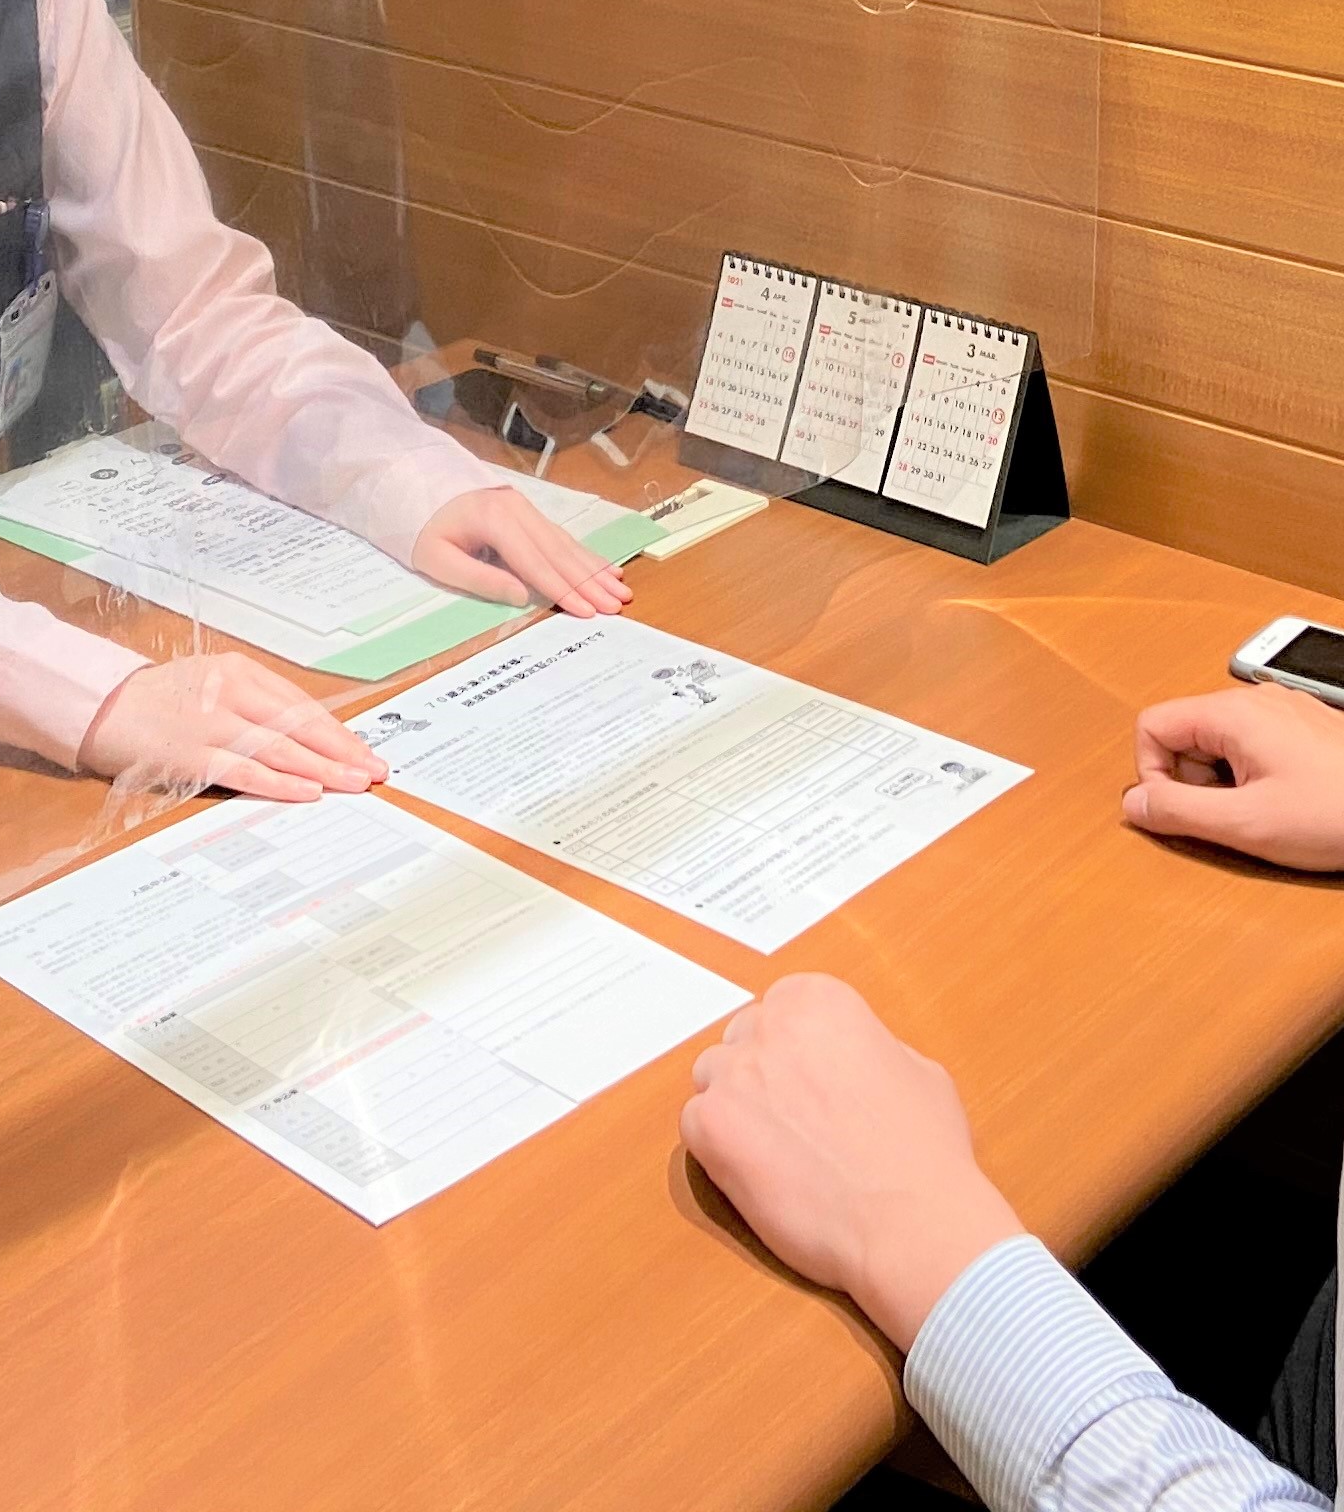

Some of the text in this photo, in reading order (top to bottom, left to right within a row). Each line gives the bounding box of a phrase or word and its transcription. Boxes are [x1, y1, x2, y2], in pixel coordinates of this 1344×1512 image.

[760, 287, 770, 301] 4
[769, 320, 797, 335] 1 2 3
[847, 311, 858, 325] 5
[717, 331, 723, 339] 4
[740, 338, 746, 346] 6
[751, 341, 758, 349] 7
[762, 343, 768, 352] 8
[775, 347, 780, 355] 9
[784, 350, 794, 359] 10
[966, 343, 976, 359] 3
[711, 353, 719, 363] 11
[722, 356, 731, 366] 12
[734, 360, 742, 370] 13
[745, 363, 754, 373] 14
[767, 370, 777, 379] 16
[779, 373, 789, 382] 17
[814, 359, 820, 367] 9
[825, 362, 834, 372] 10
[836, 365, 845, 375] 11
[705, 377, 714, 386] 18
[716, 379, 726, 389] 19
[727, 383, 737, 392] 20
[750, 390, 760, 400] 22
[773, 397, 783, 407] 24
[937, 368, 941, 377] 1
[949, 372, 955, 381] 2
[961, 375, 968, 384] 3
[975, 379, 981, 388] 4
[988, 383, 993, 392] 5
[1000, 386, 1007, 396] 6
[819, 386, 828, 394] 17
[831, 389, 840, 398] 18
[843, 392, 852, 401] 19
[854, 396, 864, 405] 20
[699, 400, 708, 409] 25
[710, 403, 720, 413] 26
[721, 406, 731, 415] 27
[732, 410, 742, 420] 28
[744, 413, 754, 422] 29
[930, 393, 936, 402] 8
[943, 396, 949, 405] 9
[954, 399, 965, 410] 10
[967, 403, 977, 413] 11
[980, 406, 991, 418] 12
[994, 411, 1003, 422] 13
[813, 409, 823, 419] 24
[825, 413, 834, 422] 25
[848, 420, 858, 429] 27
[875, 428, 885, 437] 29
[910, 413, 998, 446] 14 15 16 17 18 19 20
[795, 429, 817, 442] 30 31
[904, 438, 993, 470] 21 22 23 24 25 26 27
[898, 461, 946, 484] 28 29 30 31
